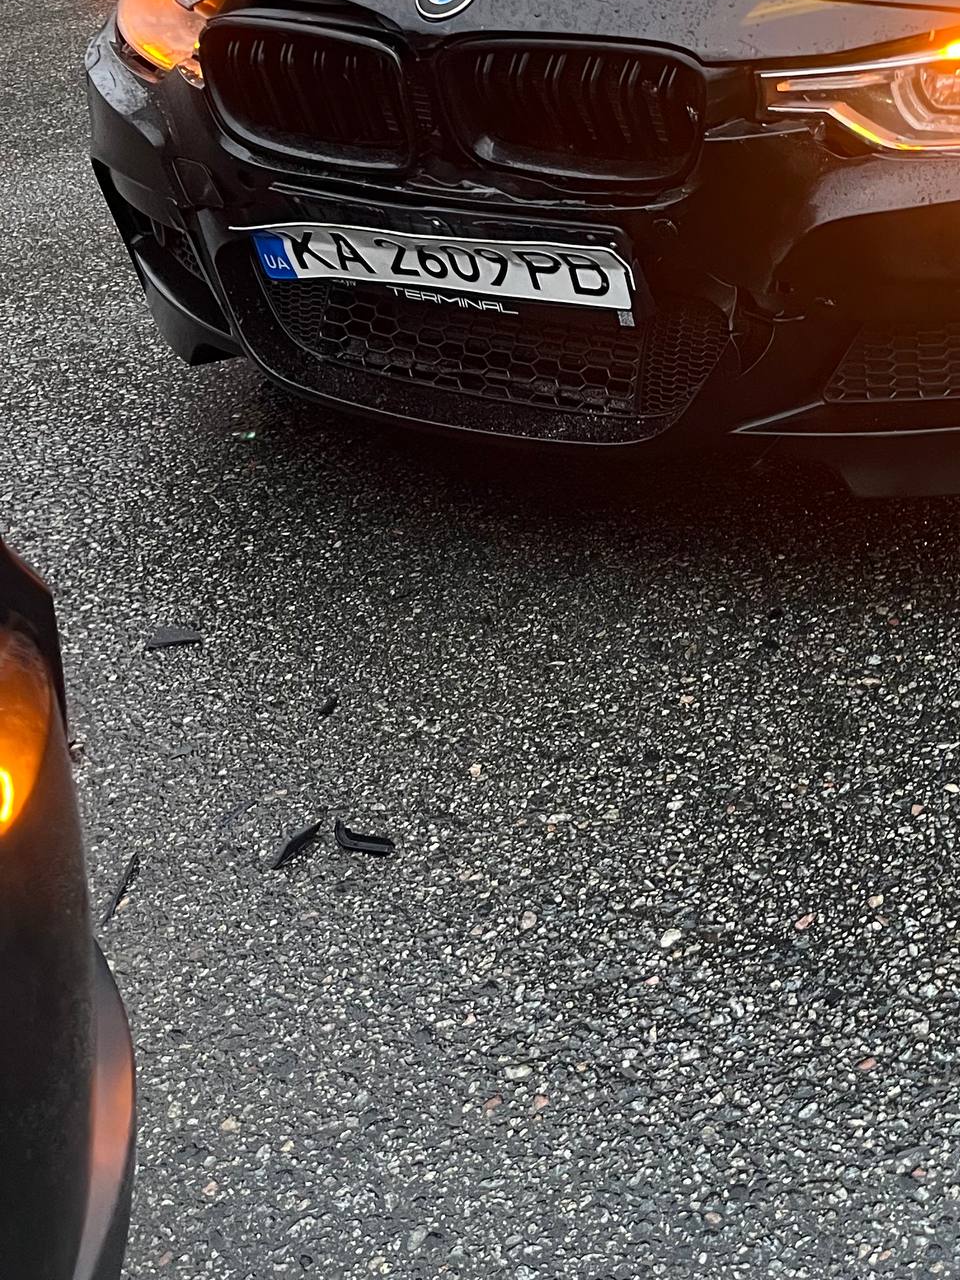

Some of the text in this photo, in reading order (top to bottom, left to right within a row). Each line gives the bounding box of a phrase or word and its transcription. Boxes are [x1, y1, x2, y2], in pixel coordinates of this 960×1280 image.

[264, 253, 290, 270] UA
[275, 231, 610, 296] KA 2609 PB
[386, 285, 519, 315] TERMINAL
